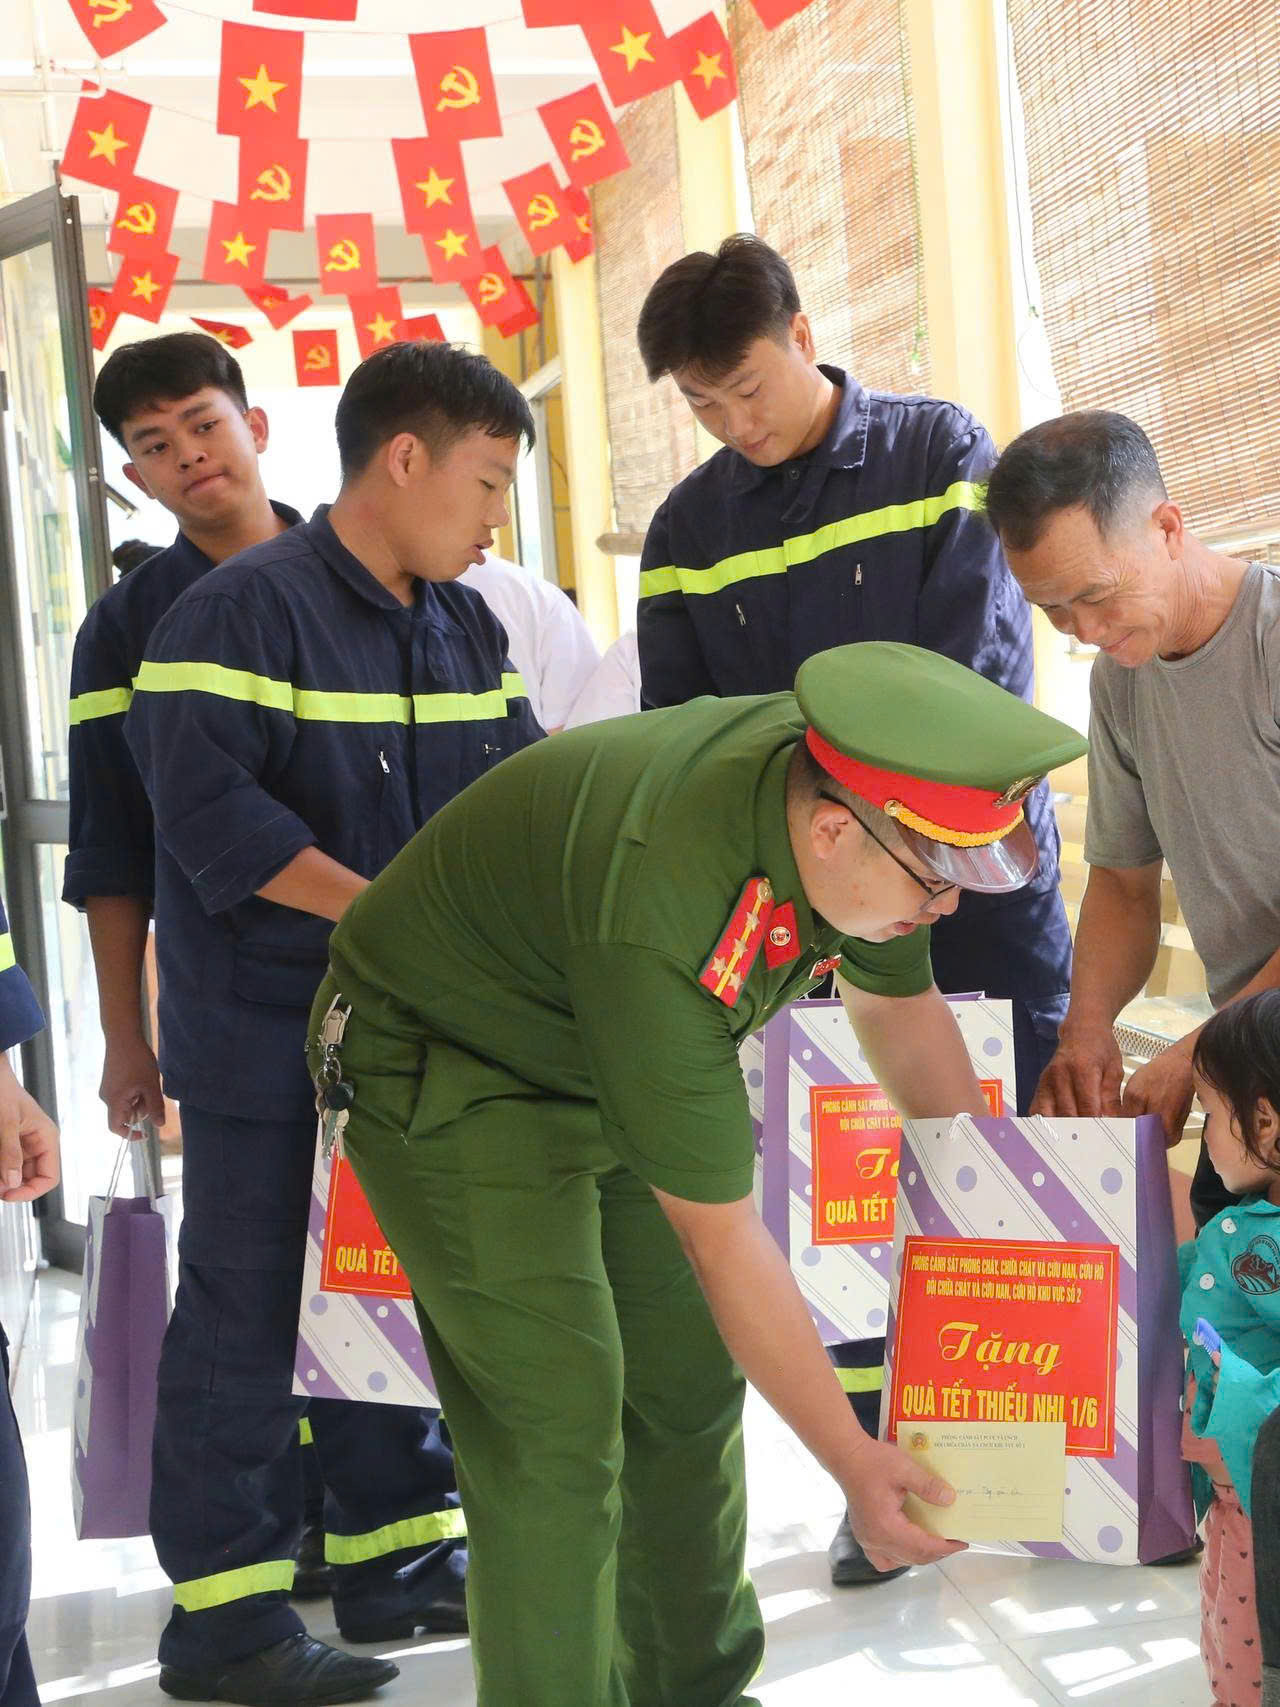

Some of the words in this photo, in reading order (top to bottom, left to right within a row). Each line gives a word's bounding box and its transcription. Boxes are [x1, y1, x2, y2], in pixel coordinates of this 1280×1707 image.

[825, 1194, 858, 1227] QUÀ
[861, 1191, 889, 1223] TẾT
[336, 1242, 368, 1274] QUÀ
[1076, 1287, 1083, 1303] 2
[938, 1321, 1063, 1376] Tặng
[902, 1379, 936, 1417] QUÀ
[941, 1378, 972, 1418] TẾT
[976, 1381, 1028, 1422] THIẾU
[1032, 1392, 1065, 1422] NHI
[1071, 1396, 1099, 1429] 1/6
